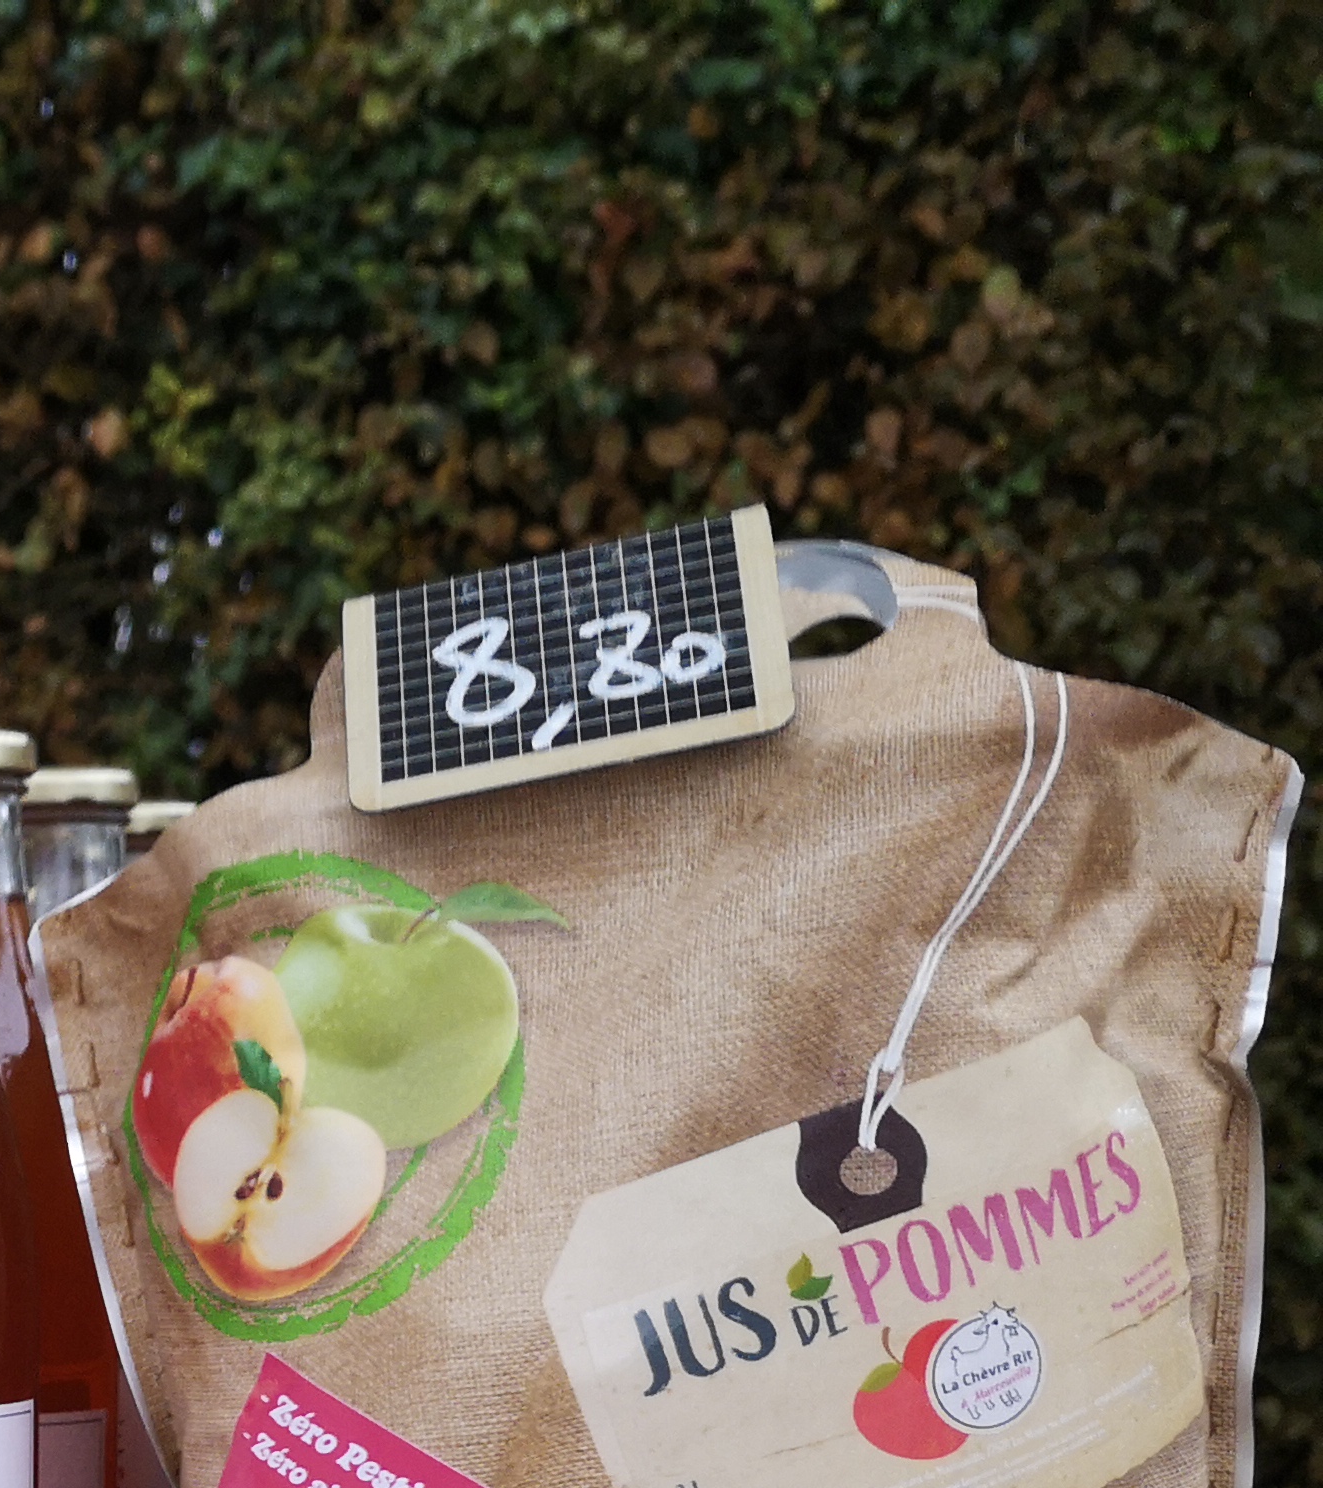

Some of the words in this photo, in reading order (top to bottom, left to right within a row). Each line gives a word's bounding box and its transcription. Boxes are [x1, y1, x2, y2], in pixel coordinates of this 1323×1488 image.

[432, 609, 726, 751] 8,80
[633, 1275, 778, 1398] JUS
[790, 1294, 849, 1347] DE
[837, 1129, 1142, 1327] POMMES
[941, 1381, 959, 1394] La
[962, 1361, 1010, 1387] Chèvre
[1012, 1350, 1034, 1367] Rit
[269, 1393, 339, 1455] Zéro
[250, 1432, 308, 1486] Zéro
